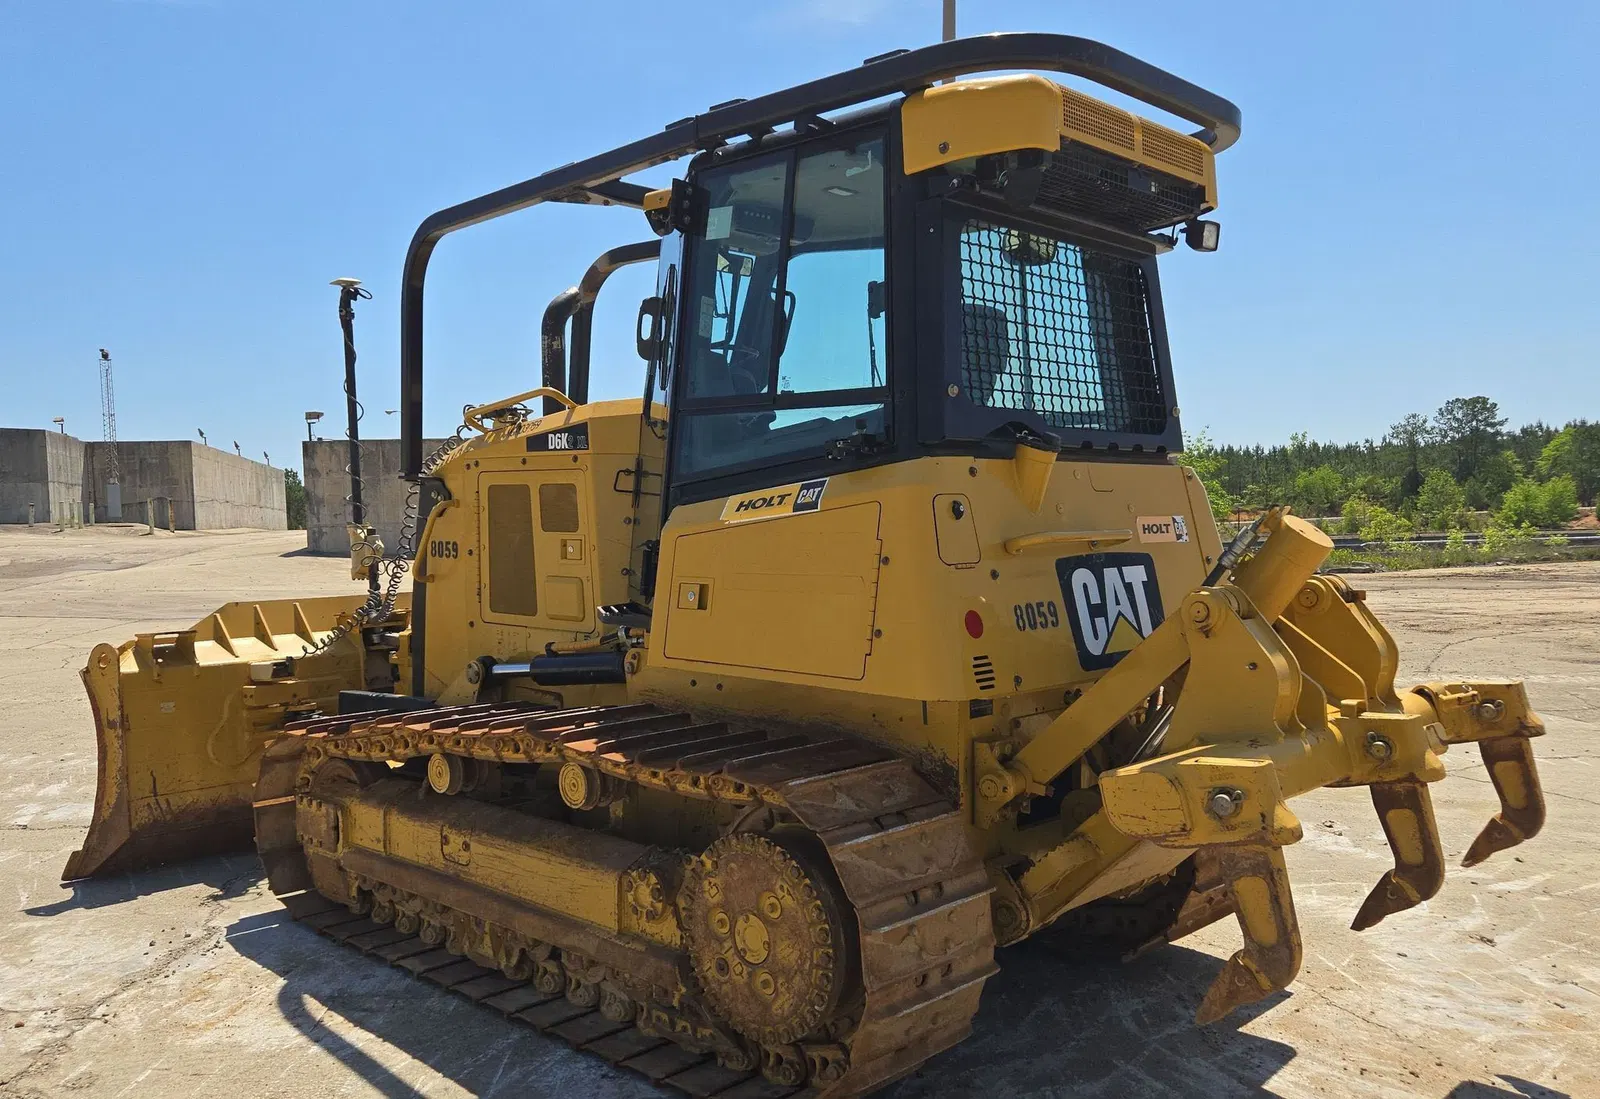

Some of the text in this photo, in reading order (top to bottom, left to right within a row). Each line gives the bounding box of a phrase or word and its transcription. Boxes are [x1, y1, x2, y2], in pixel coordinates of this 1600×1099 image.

[735, 487, 822, 512] HOLT CAT
[1142, 524, 1170, 534] HOLT
[431, 540, 459, 559] 8059
[1013, 600, 1060, 632] 8059
[1071, 564, 1154, 656] CAT
